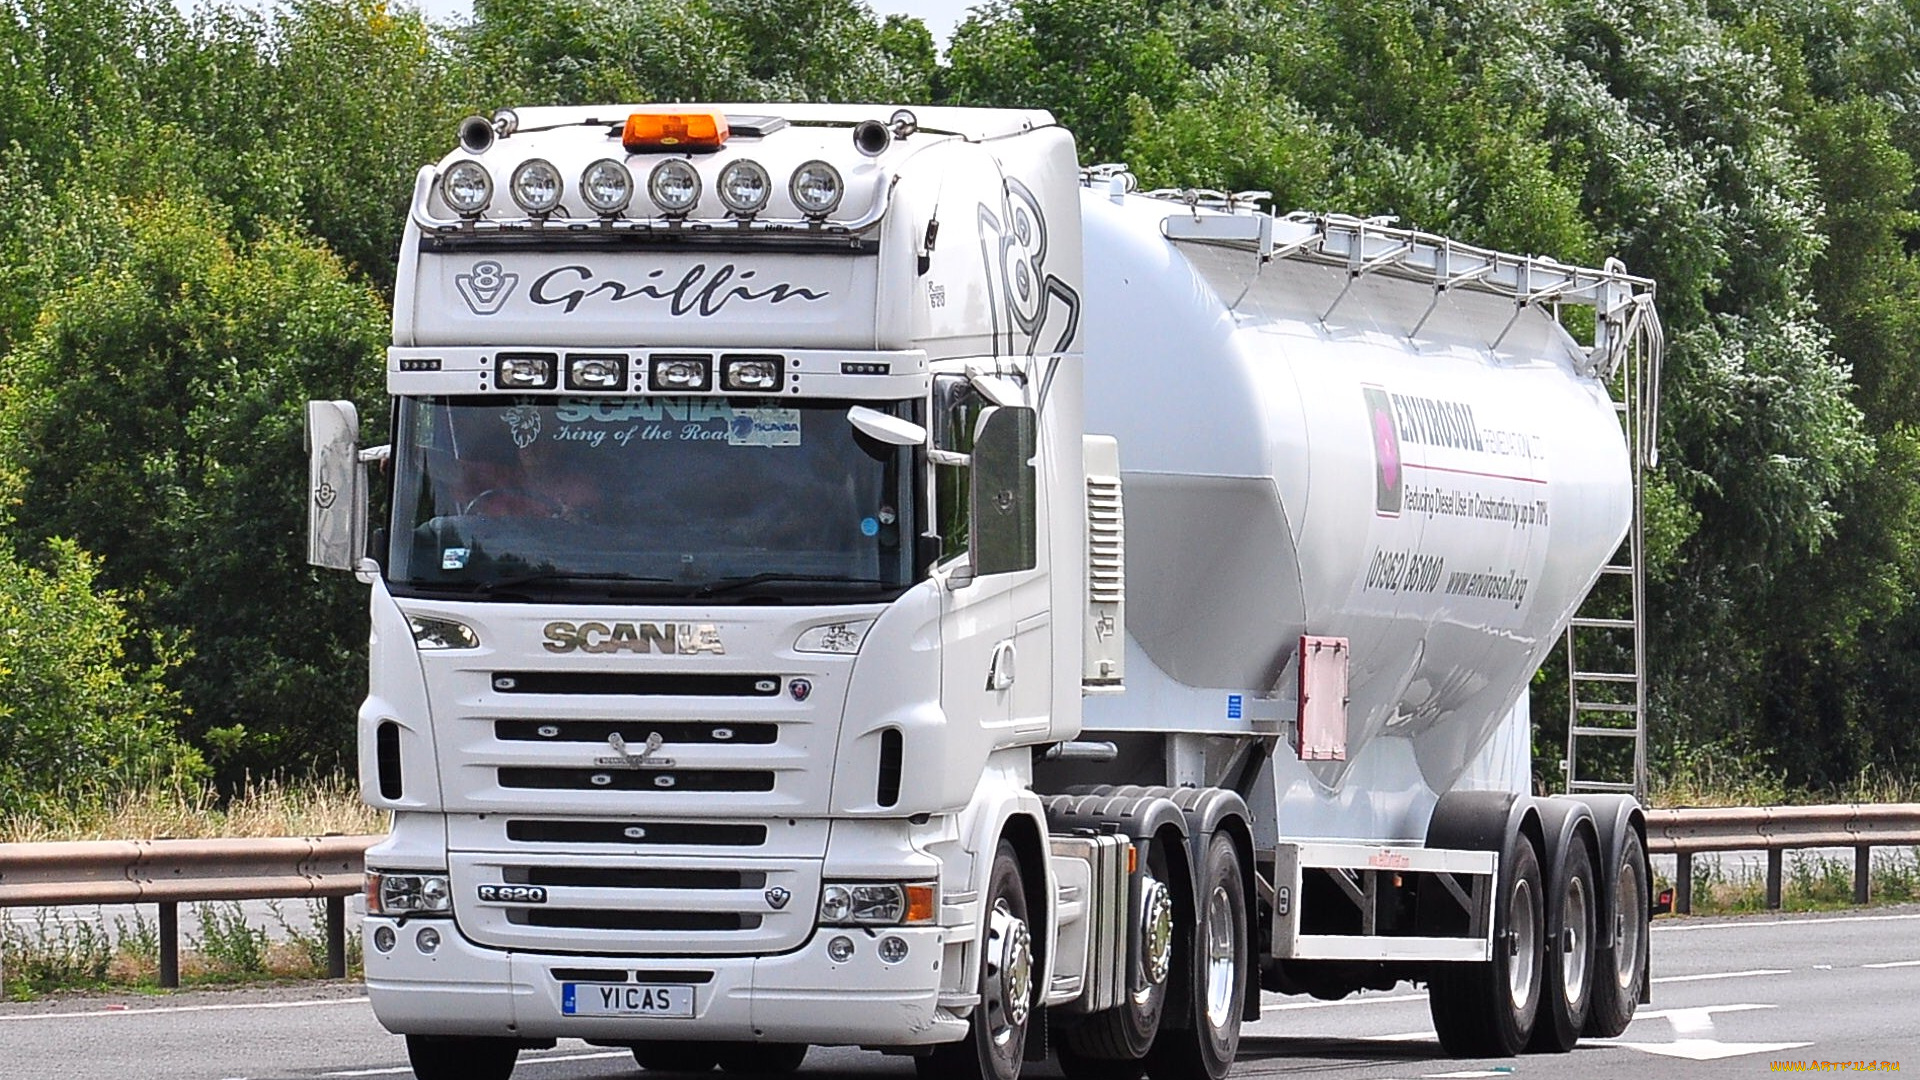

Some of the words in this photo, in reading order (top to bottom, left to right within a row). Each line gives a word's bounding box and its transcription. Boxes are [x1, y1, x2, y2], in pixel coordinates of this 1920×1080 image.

[529, 264, 829, 317] Griffin
[556, 395, 735, 422] SCANIA
[1391, 394, 1484, 453] ENVIROSOIL
[553, 424, 606, 448] King
[613, 424, 638, 447] of
[641, 424, 672, 440] the
[1404, 484, 1435, 520] Reducing
[1435, 487, 1454, 515] Diesel
[1454, 490, 1467, 517] Use
[1467, 491, 1474, 517] in
[1474, 492, 1512, 522] Construction
[1363, 544, 1411, 596] (01962)
[1445, 566, 1529, 610] www.envirosoil.org
[542, 621, 726, 655] SCANIA
[480, 886, 496, 900] R
[498, 887, 543, 901] 620
